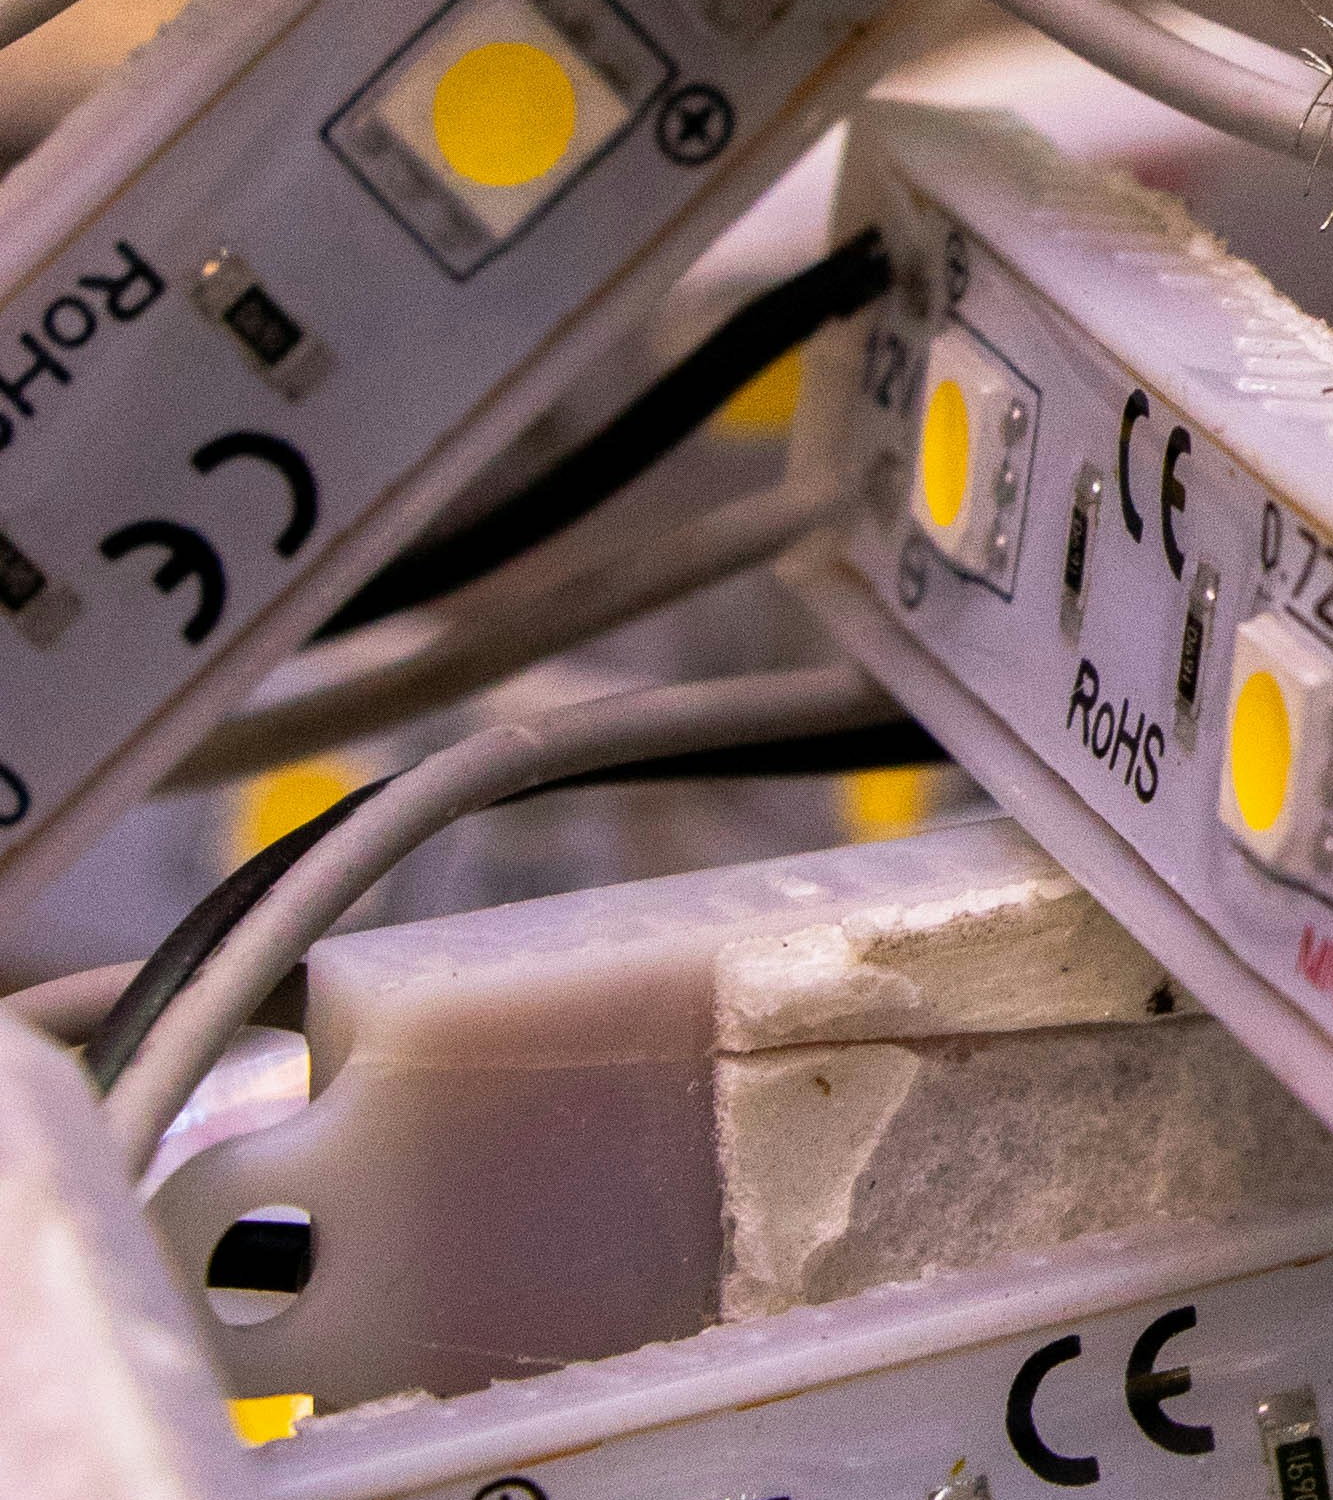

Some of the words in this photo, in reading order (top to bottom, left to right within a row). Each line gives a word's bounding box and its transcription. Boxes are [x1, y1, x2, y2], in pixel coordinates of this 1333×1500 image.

[0, 240, 166, 452] RoH
[98, 430, 318, 648] CE
[1118, 387, 1192, 582] CE
[1065, 657, 1166, 804] RoHS
[1005, 1304, 1216, 1487] CE
